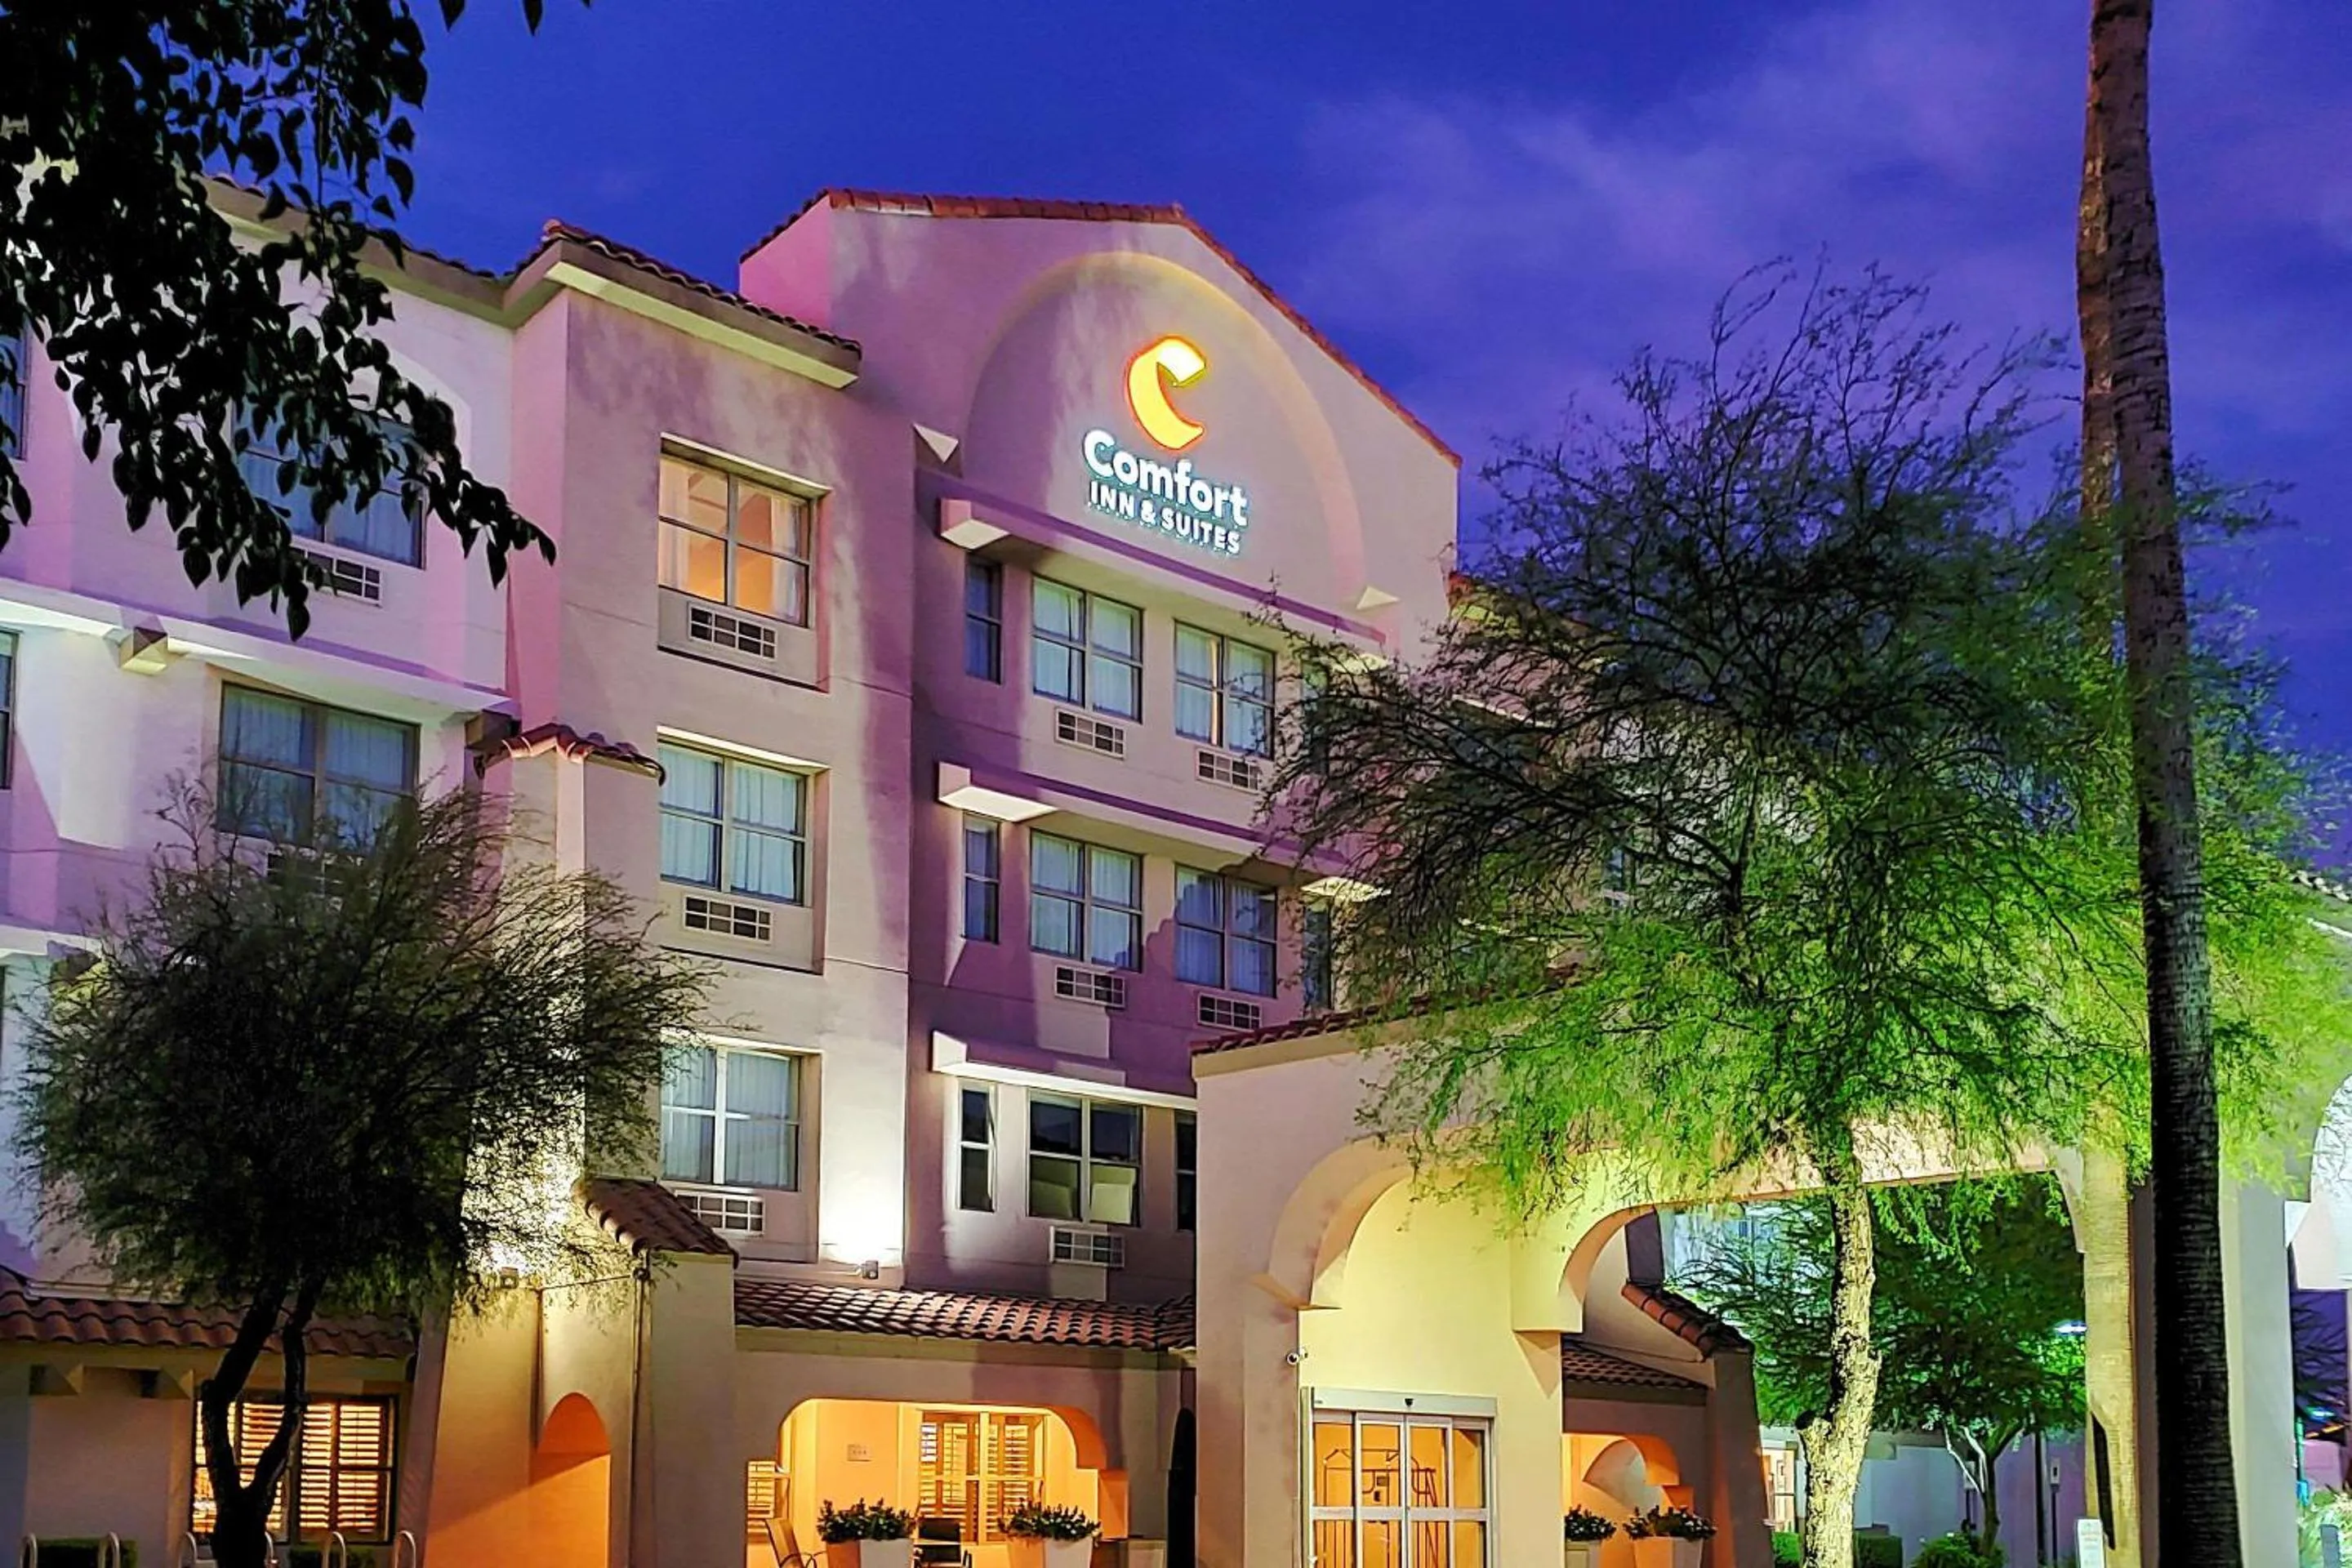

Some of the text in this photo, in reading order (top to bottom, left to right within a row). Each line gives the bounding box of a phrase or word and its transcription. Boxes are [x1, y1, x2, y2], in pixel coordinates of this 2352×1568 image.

[1084, 430, 1247, 526] Comfort
[1090, 480, 1241, 554] INN & SUITES
